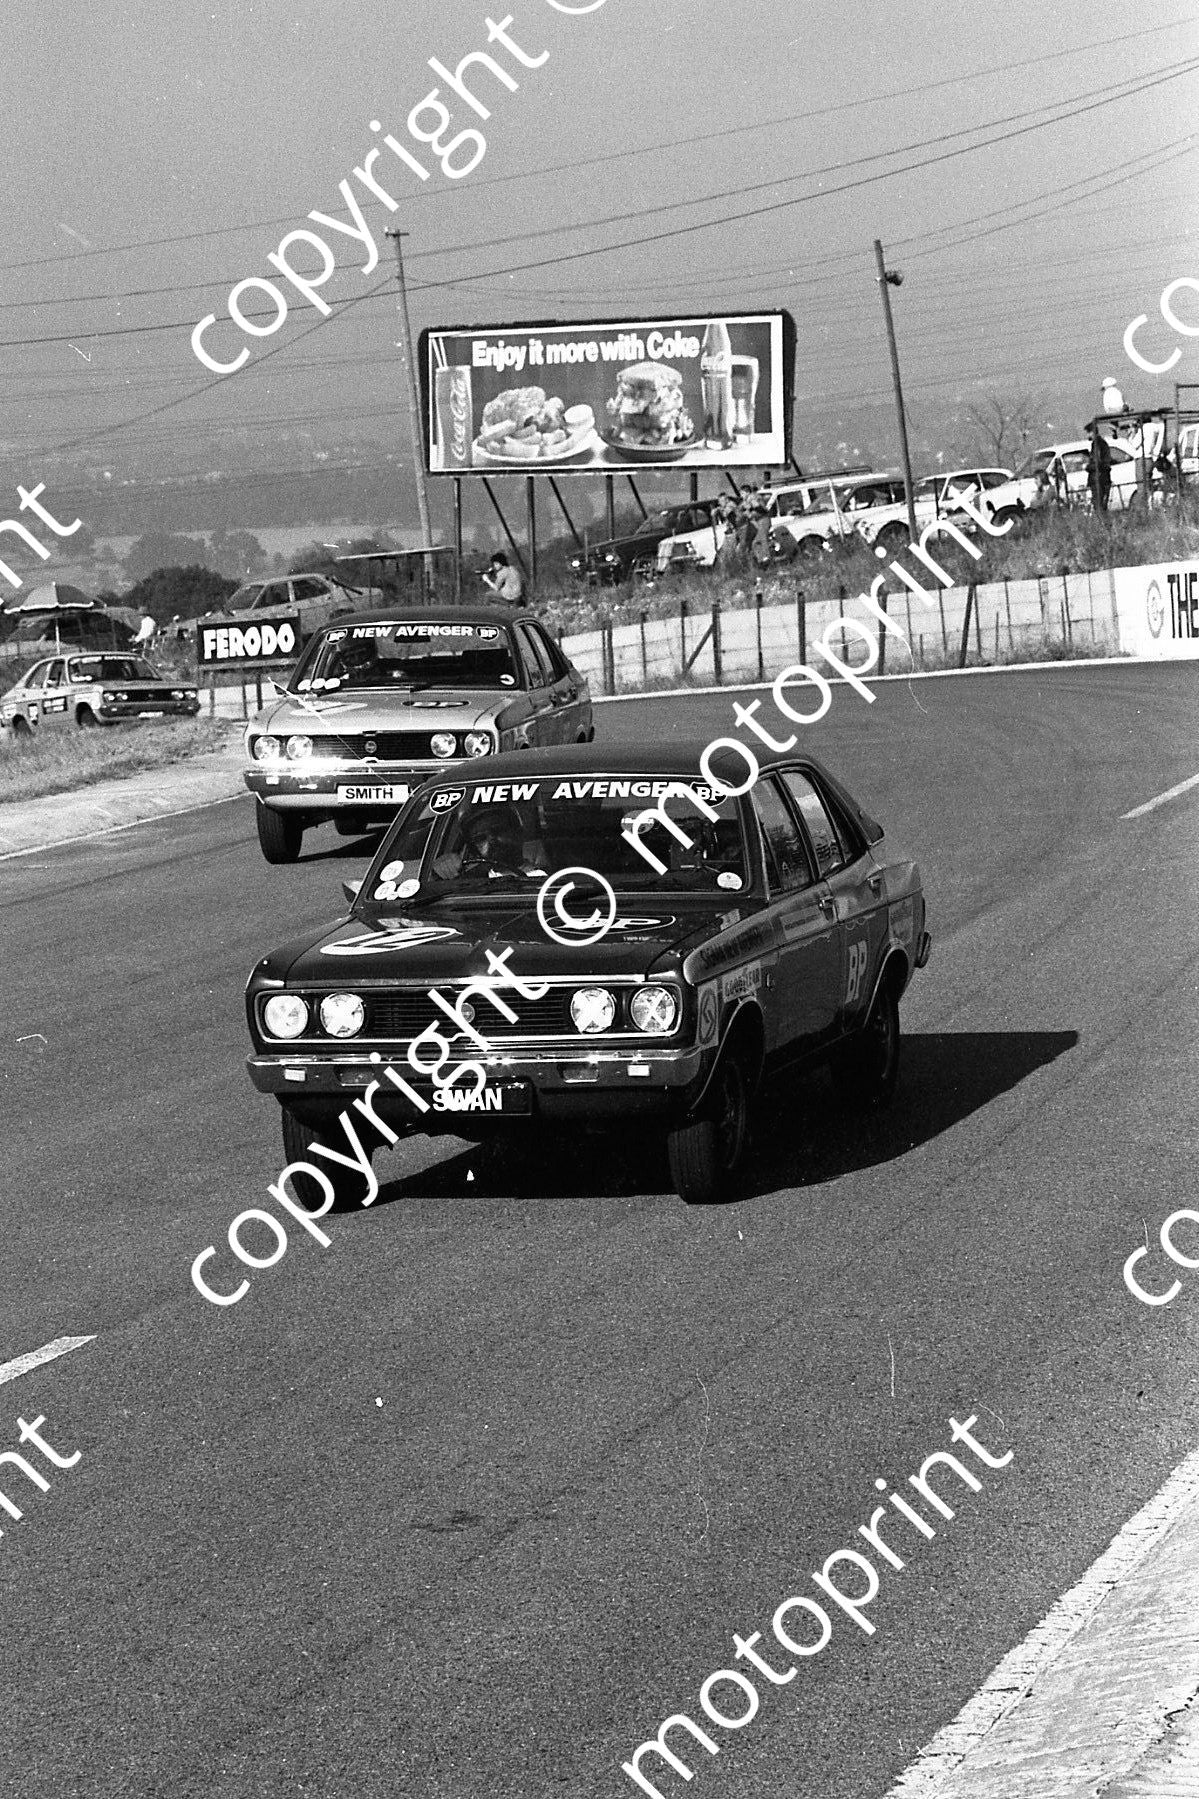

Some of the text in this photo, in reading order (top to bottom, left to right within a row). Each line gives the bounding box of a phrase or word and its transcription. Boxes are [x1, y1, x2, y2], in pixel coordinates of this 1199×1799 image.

[472, 331, 700, 372] Enjoy it more with Coke
[1167, 572, 1199, 639] THE
[203, 623, 295, 660] FERODO
[352, 626, 473, 639] NEW AVENGER
[345, 787, 393, 799] SMITH
[433, 792, 461, 809] BP
[471, 783, 539, 804] NEW
[432, 1087, 502, 1111] SWAN
